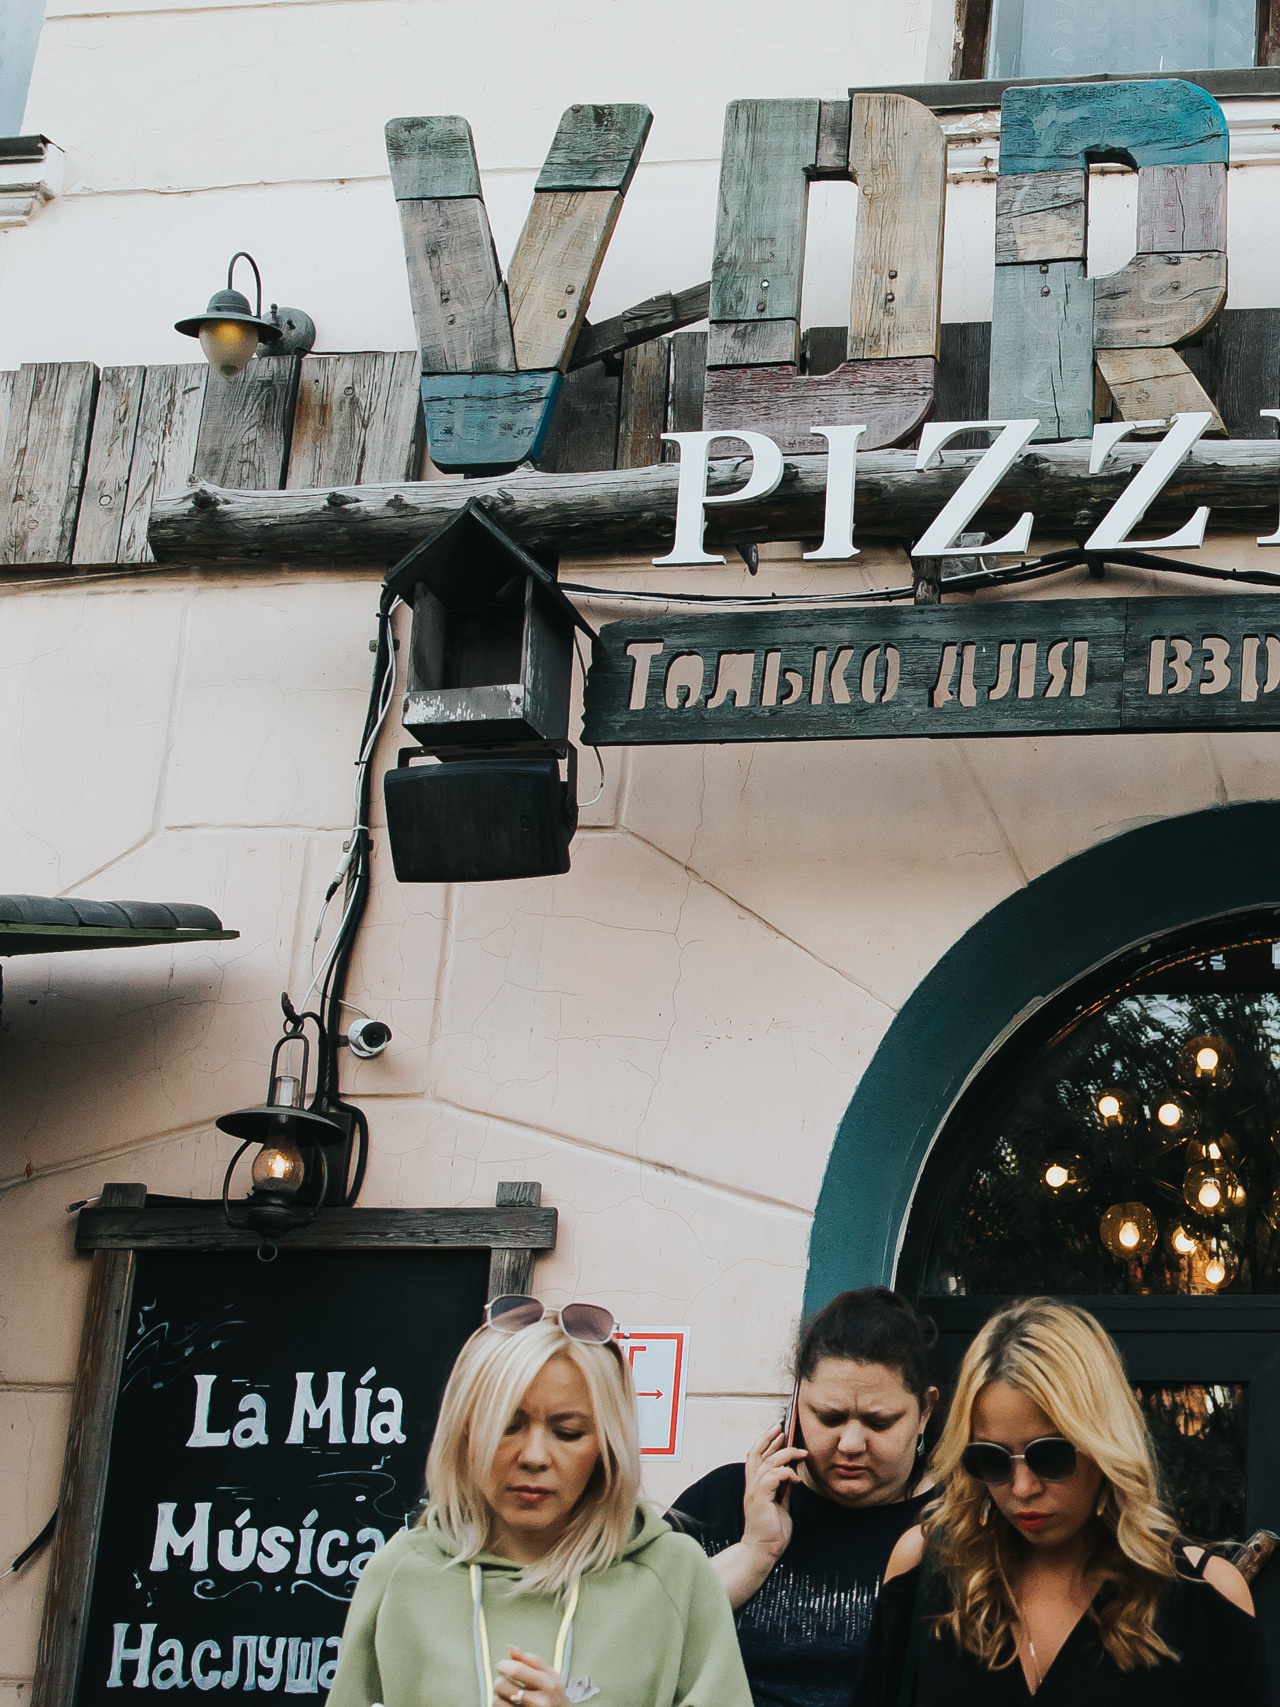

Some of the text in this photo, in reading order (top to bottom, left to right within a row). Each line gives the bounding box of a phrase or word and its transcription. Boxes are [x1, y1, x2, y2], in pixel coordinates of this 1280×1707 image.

[626, 638, 901, 710] Только
[929, 637, 1089, 708] для
[186, 1366, 407, 1448] La Mía
